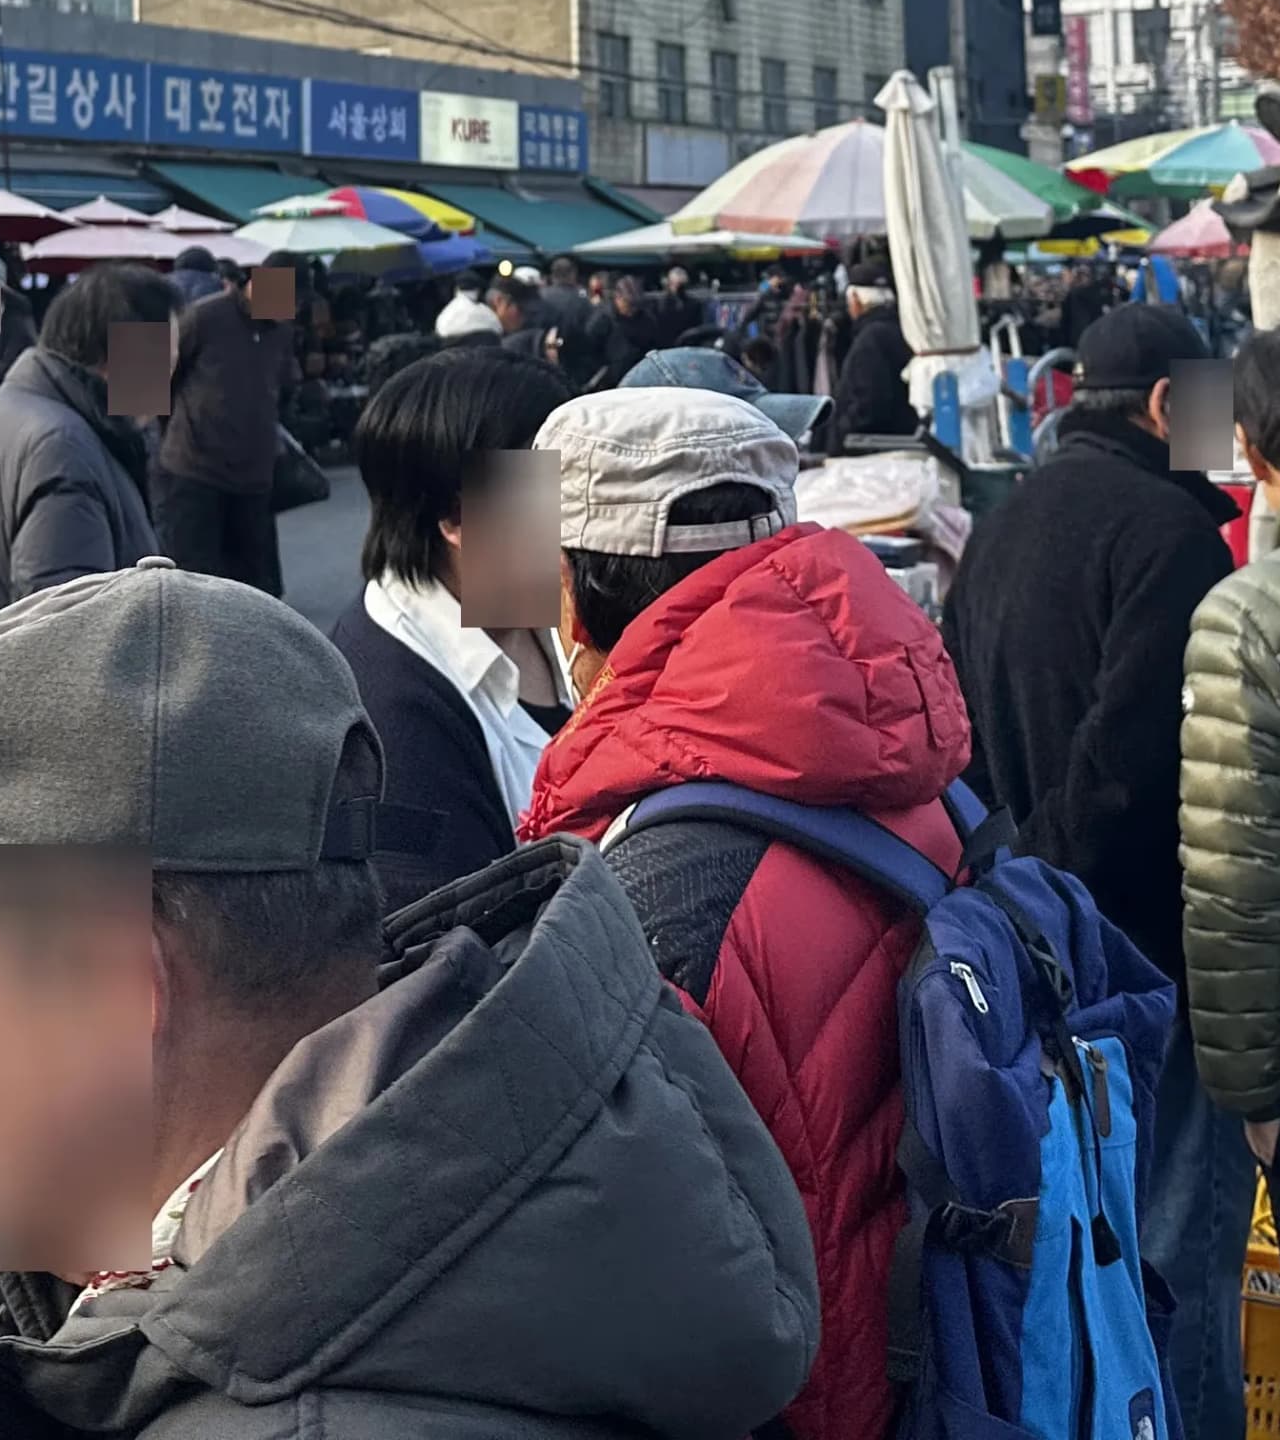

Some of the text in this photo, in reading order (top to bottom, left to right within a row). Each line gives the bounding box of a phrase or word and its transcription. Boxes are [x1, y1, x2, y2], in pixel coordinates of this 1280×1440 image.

[165, 76, 291, 140] 대호전자
[328, 100, 407, 144] 서울상회
[451, 117, 492, 145] KURE
